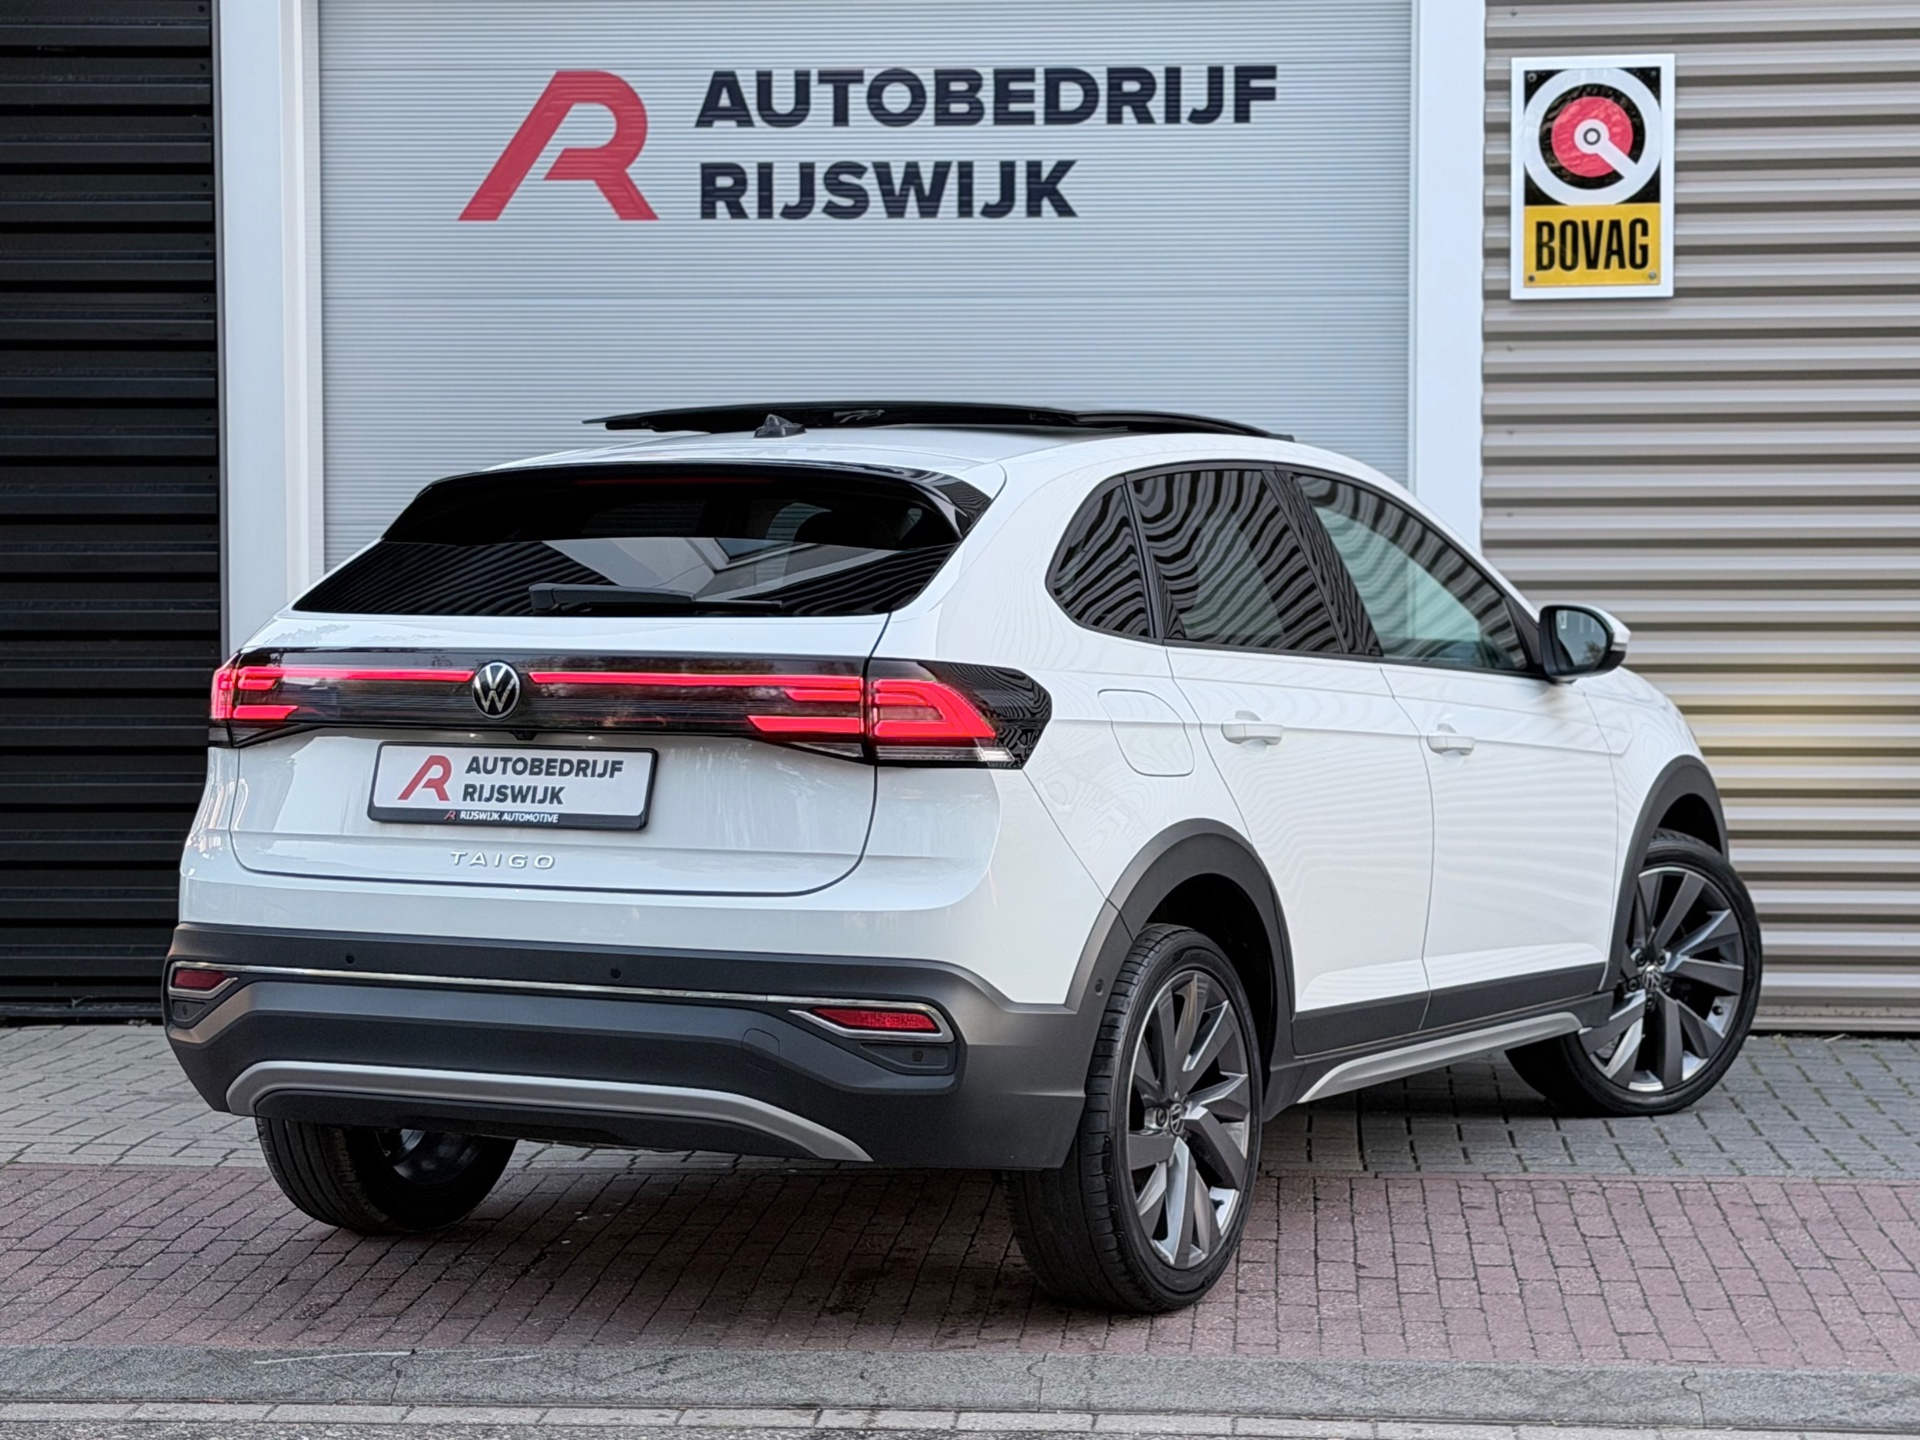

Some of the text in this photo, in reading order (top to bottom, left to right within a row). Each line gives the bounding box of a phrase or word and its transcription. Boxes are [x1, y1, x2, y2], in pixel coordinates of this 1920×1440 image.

[694, 65, 1277, 128] AUTOBEDRIJF
[699, 160, 1079, 221] RIJSWIJK
[1535, 218, 1649, 271] BOVAG
[465, 755, 624, 778] AUTOBEDRIJF
[462, 783, 565, 805] RIJSWIJK
[460, 811, 500, 821] RIJSWIJK
[501, 812, 559, 823] AUTOMOTIVE
[450, 851, 556, 869] TAIGO
